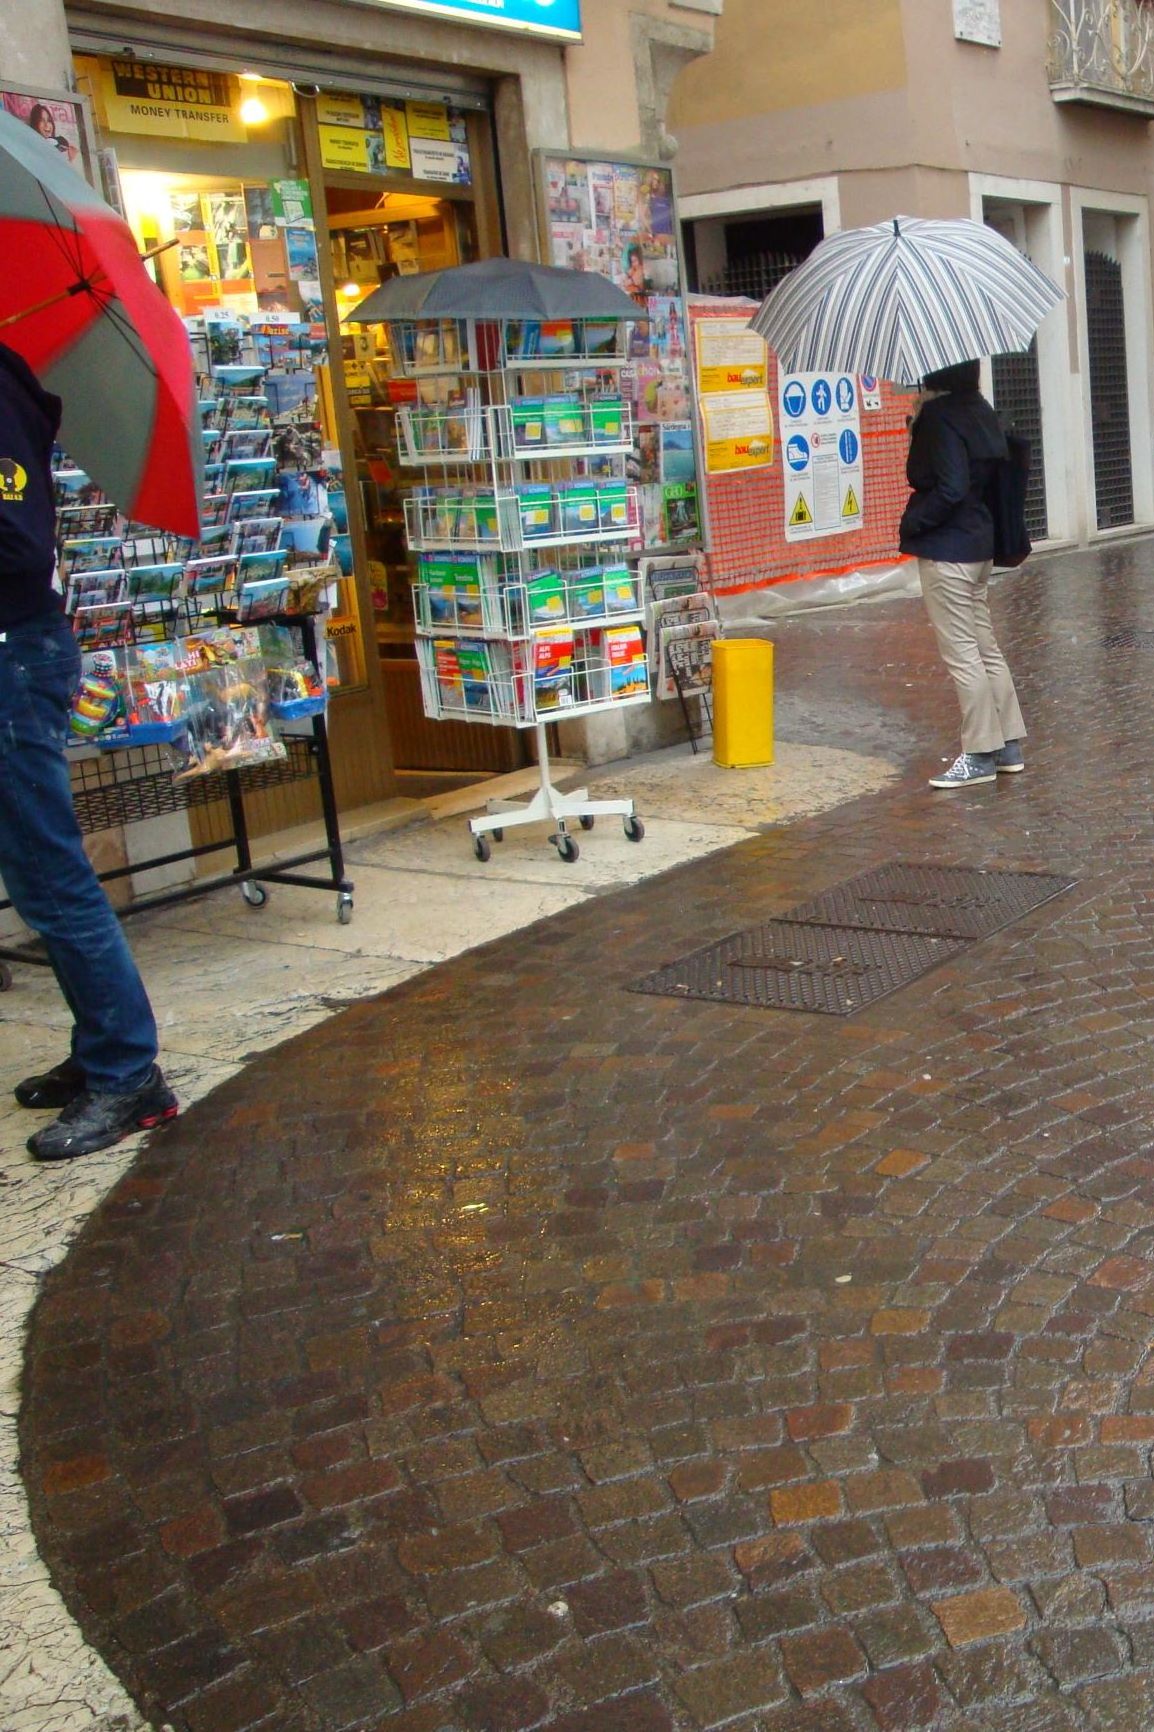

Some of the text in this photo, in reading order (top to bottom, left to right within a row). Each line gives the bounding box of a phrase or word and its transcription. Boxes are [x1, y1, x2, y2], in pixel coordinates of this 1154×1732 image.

[112, 61, 209, 87] WESTERN
[147, 82, 211, 104] UNION
[131, 104, 229, 124] MONEY TRANSFER
[327, 624, 357, 637] Kodak
